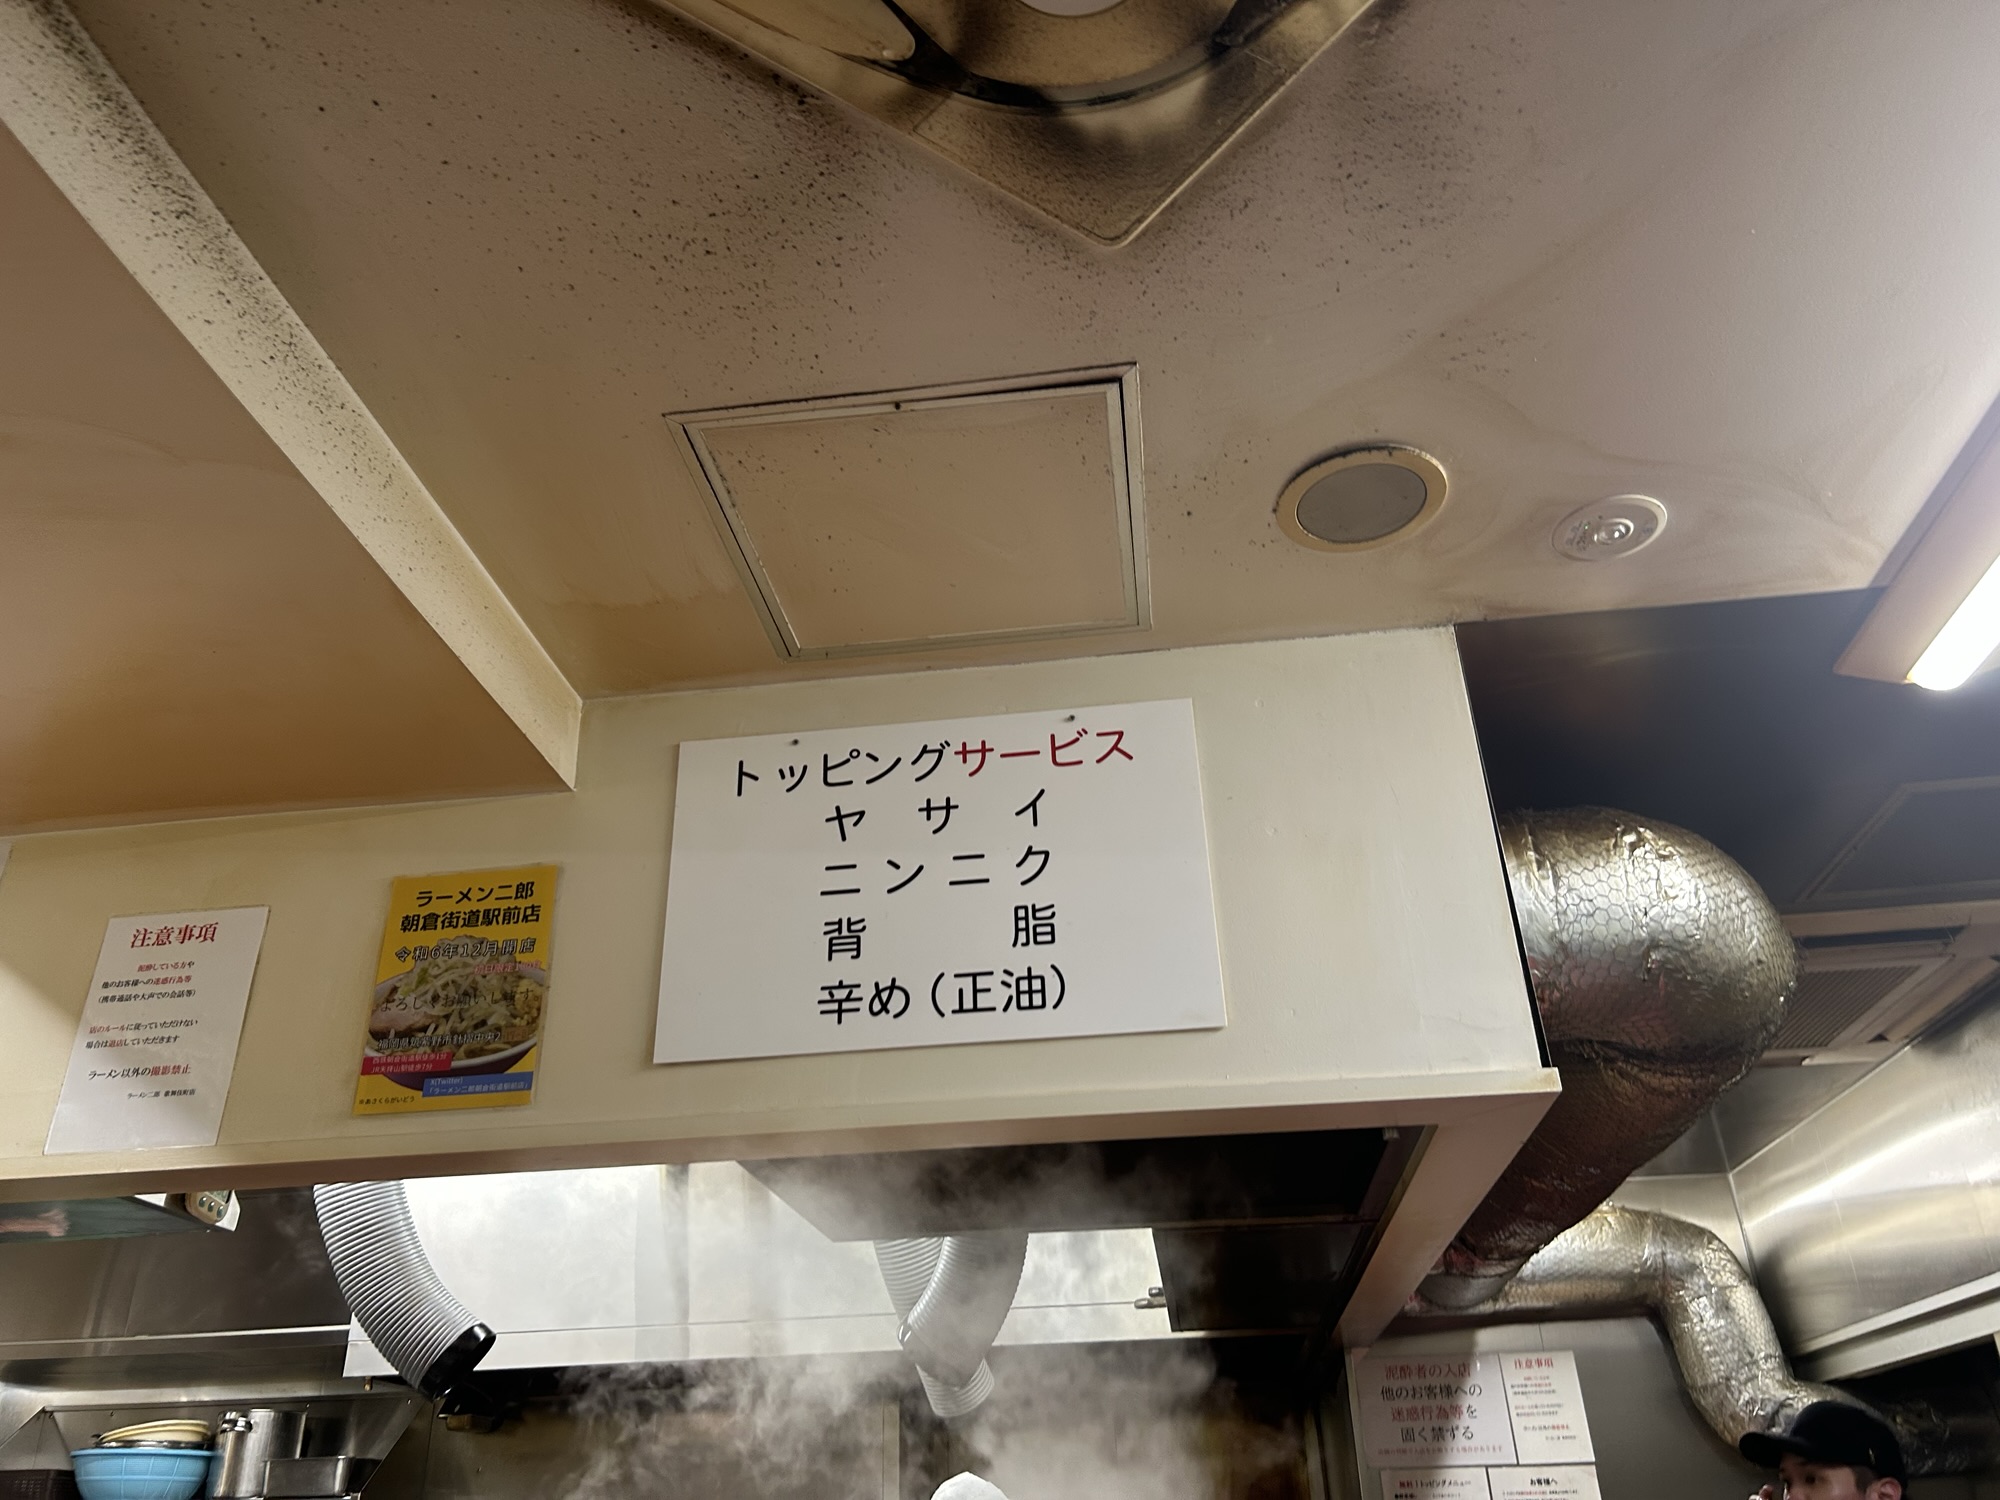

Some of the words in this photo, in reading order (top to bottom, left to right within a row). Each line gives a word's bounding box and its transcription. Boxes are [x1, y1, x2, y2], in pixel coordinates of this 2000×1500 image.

[737, 727, 1134, 797] トッピングサービス
[820, 844, 1051, 897] ニンニク
[416, 881, 535, 908] ラーメン二郎
[400, 904, 541, 933] 朝倉街道駅前店
[130, 922, 219, 949] 注意事項
[395, 937, 536, 963] 令和6年12月開店
[817, 964, 1066, 1025] 辛め（正油）
[88, 1063, 192, 1080] ラーメン以外の撮影禁止
[1381, 1383, 1483, 1401] 他のお客様への
